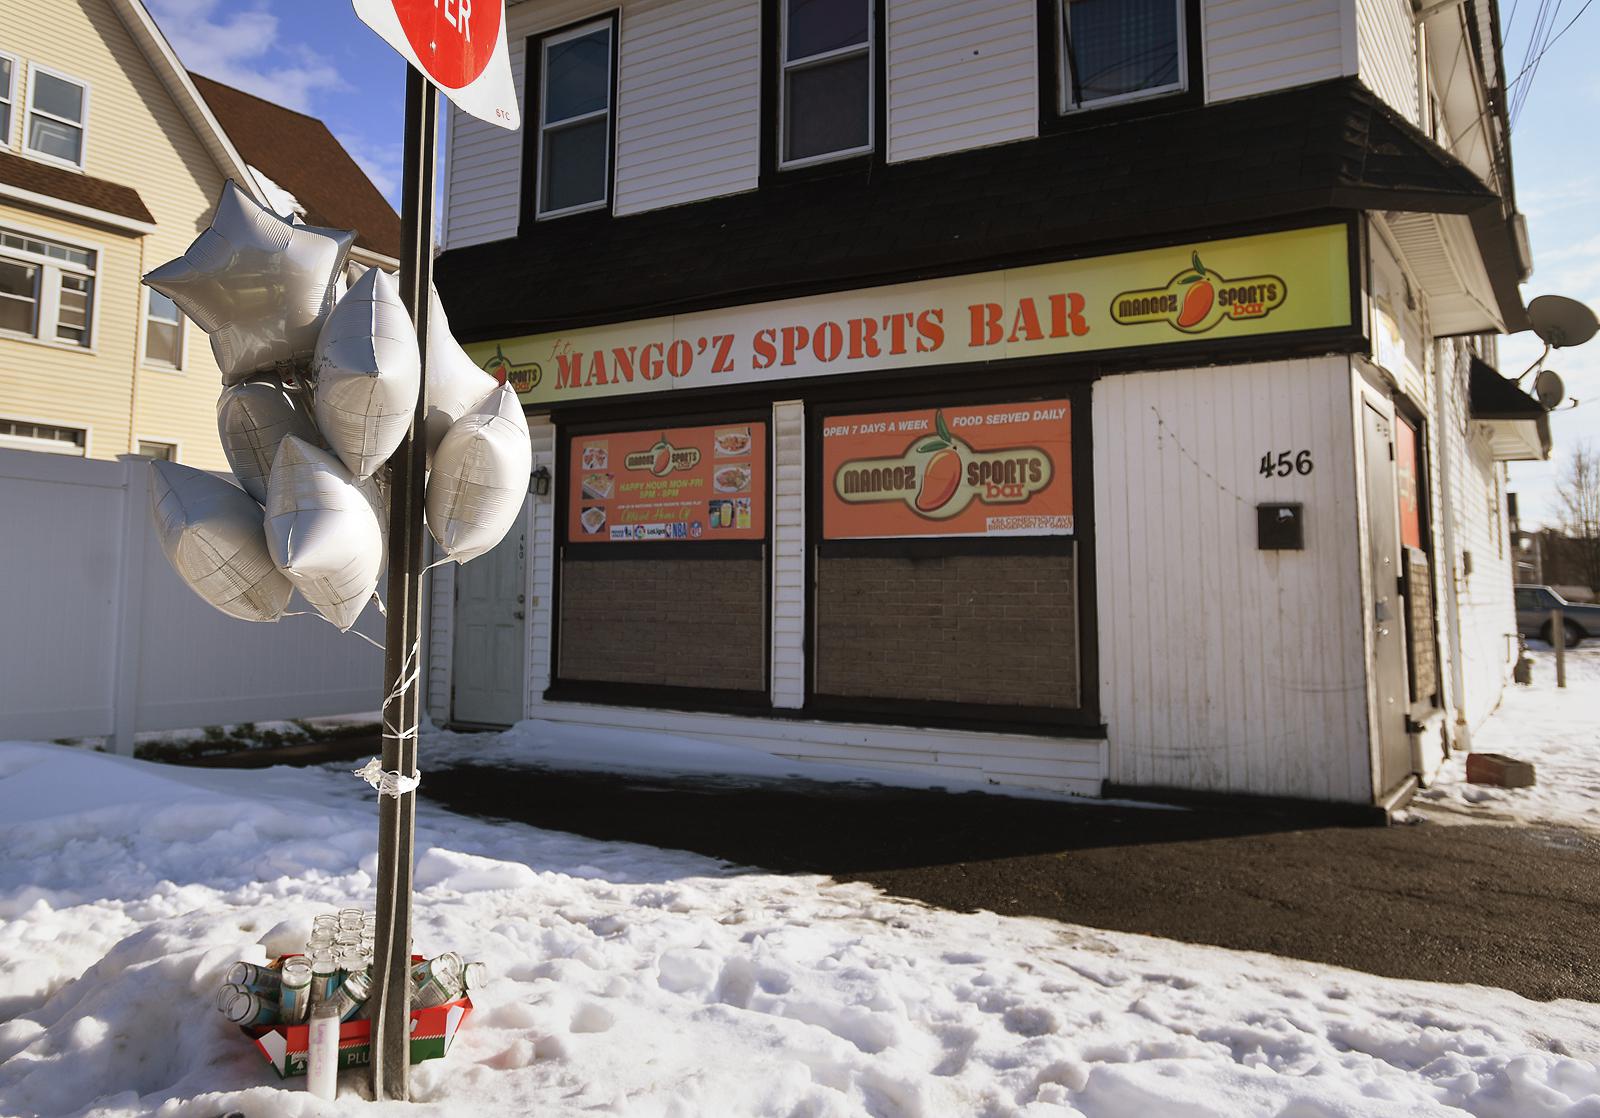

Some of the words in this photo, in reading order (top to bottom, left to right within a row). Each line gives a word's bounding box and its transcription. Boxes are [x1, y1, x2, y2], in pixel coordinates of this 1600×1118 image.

[434, 0, 472, 43] ER
[1218, 284, 1278, 307] SPORTS
[1233, 303, 1264, 316] bar
[553, 334, 735, 390] MANGO'Z
[752, 308, 945, 370] SPORTS
[968, 292, 1090, 347] BAR
[507, 369, 538, 383] SPORTS
[953, 415, 983, 427] FOOD
[986, 411, 1030, 425] SERVED
[1033, 408, 1066, 421] DAILY
[823, 426, 849, 438] OPEN
[850, 425, 858, 435] 7
[860, 423, 886, 434] DAYS
[888, 422, 896, 432] A
[898, 419, 929, 432] WEEK
[672, 451, 697, 463] SPORTS
[1259, 450, 1314, 478] 456
[967, 458, 1042, 487] SPORTS
[986, 481, 1024, 498] bar
[347, 1051, 370, 1066] PLU
